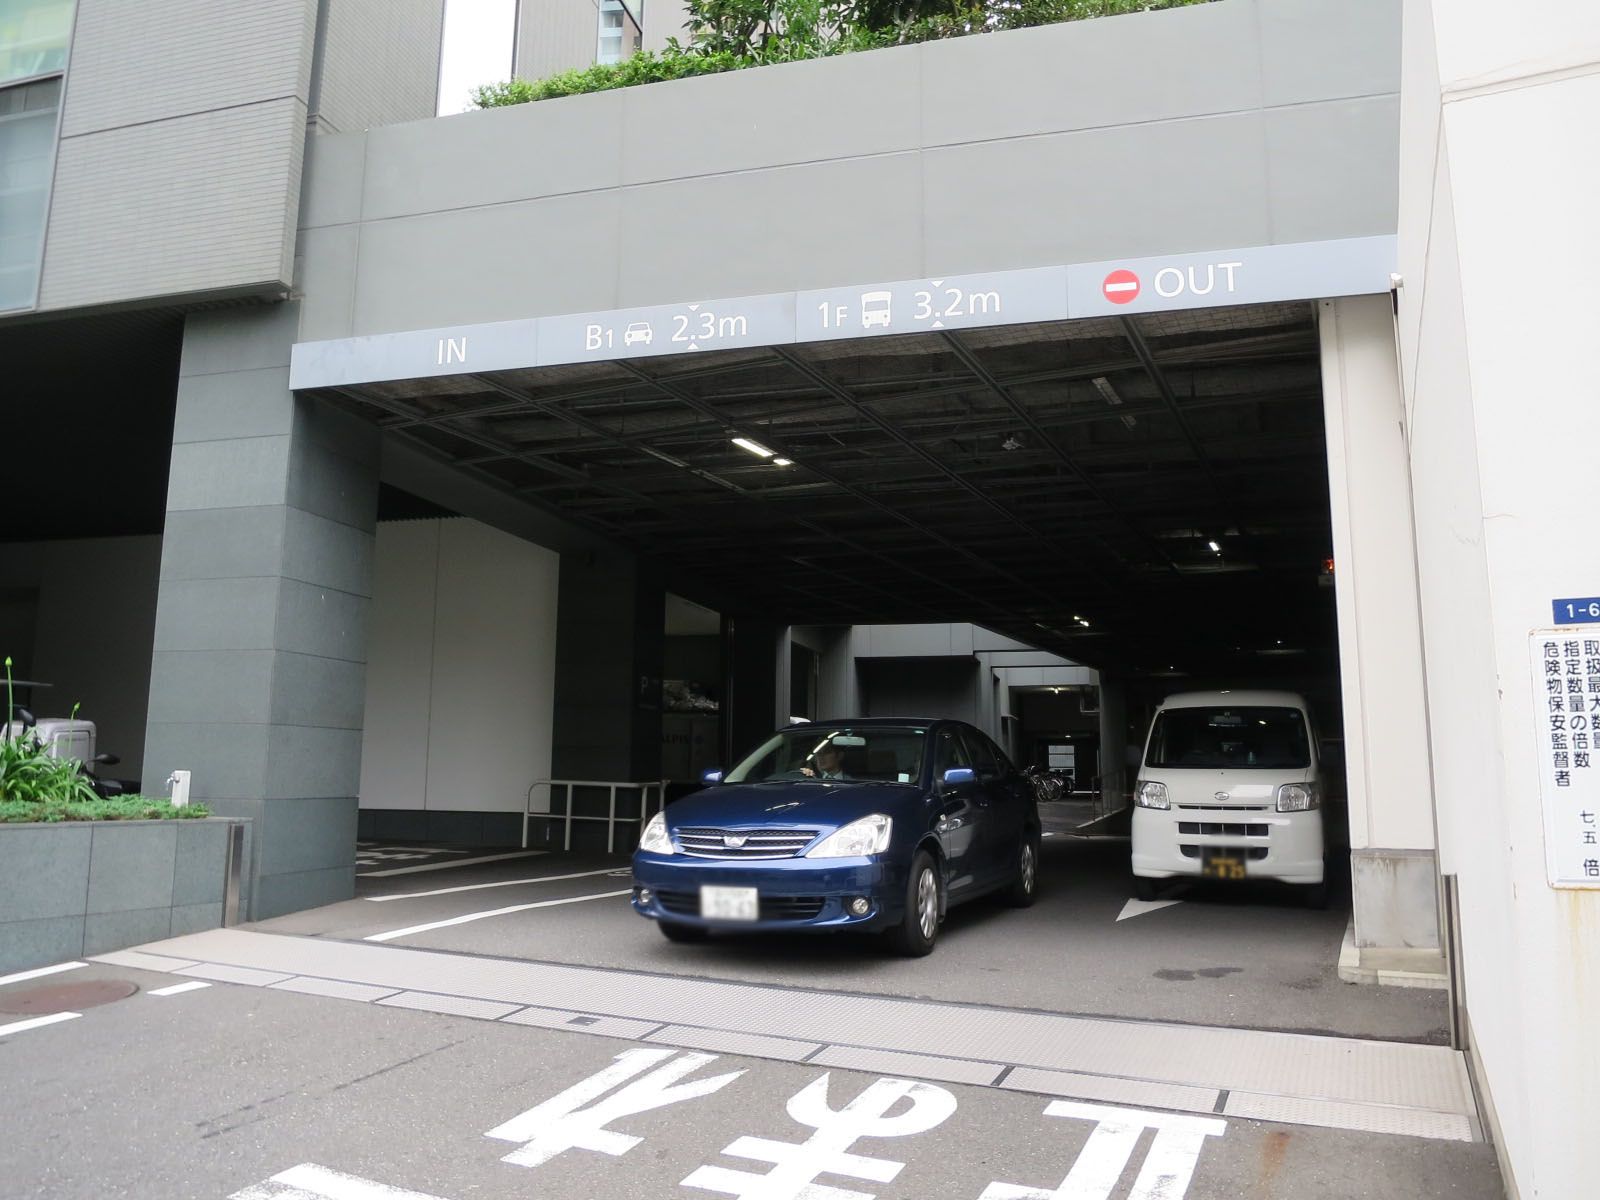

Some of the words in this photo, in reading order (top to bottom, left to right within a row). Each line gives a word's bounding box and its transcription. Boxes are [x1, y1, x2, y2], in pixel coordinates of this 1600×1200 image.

[1154, 262, 1243, 298] OUT
[819, 302, 849, 329] 1F
[915, 287, 1002, 321] 3.2m
[436, 338, 468, 366] IN
[585, 323, 615, 352] B1
[671, 312, 749, 344] 2.3m
[1543, 641, 1572, 787] 危険物保安監督者
[1563, 641, 1591, 768] 指定数量の倍数
